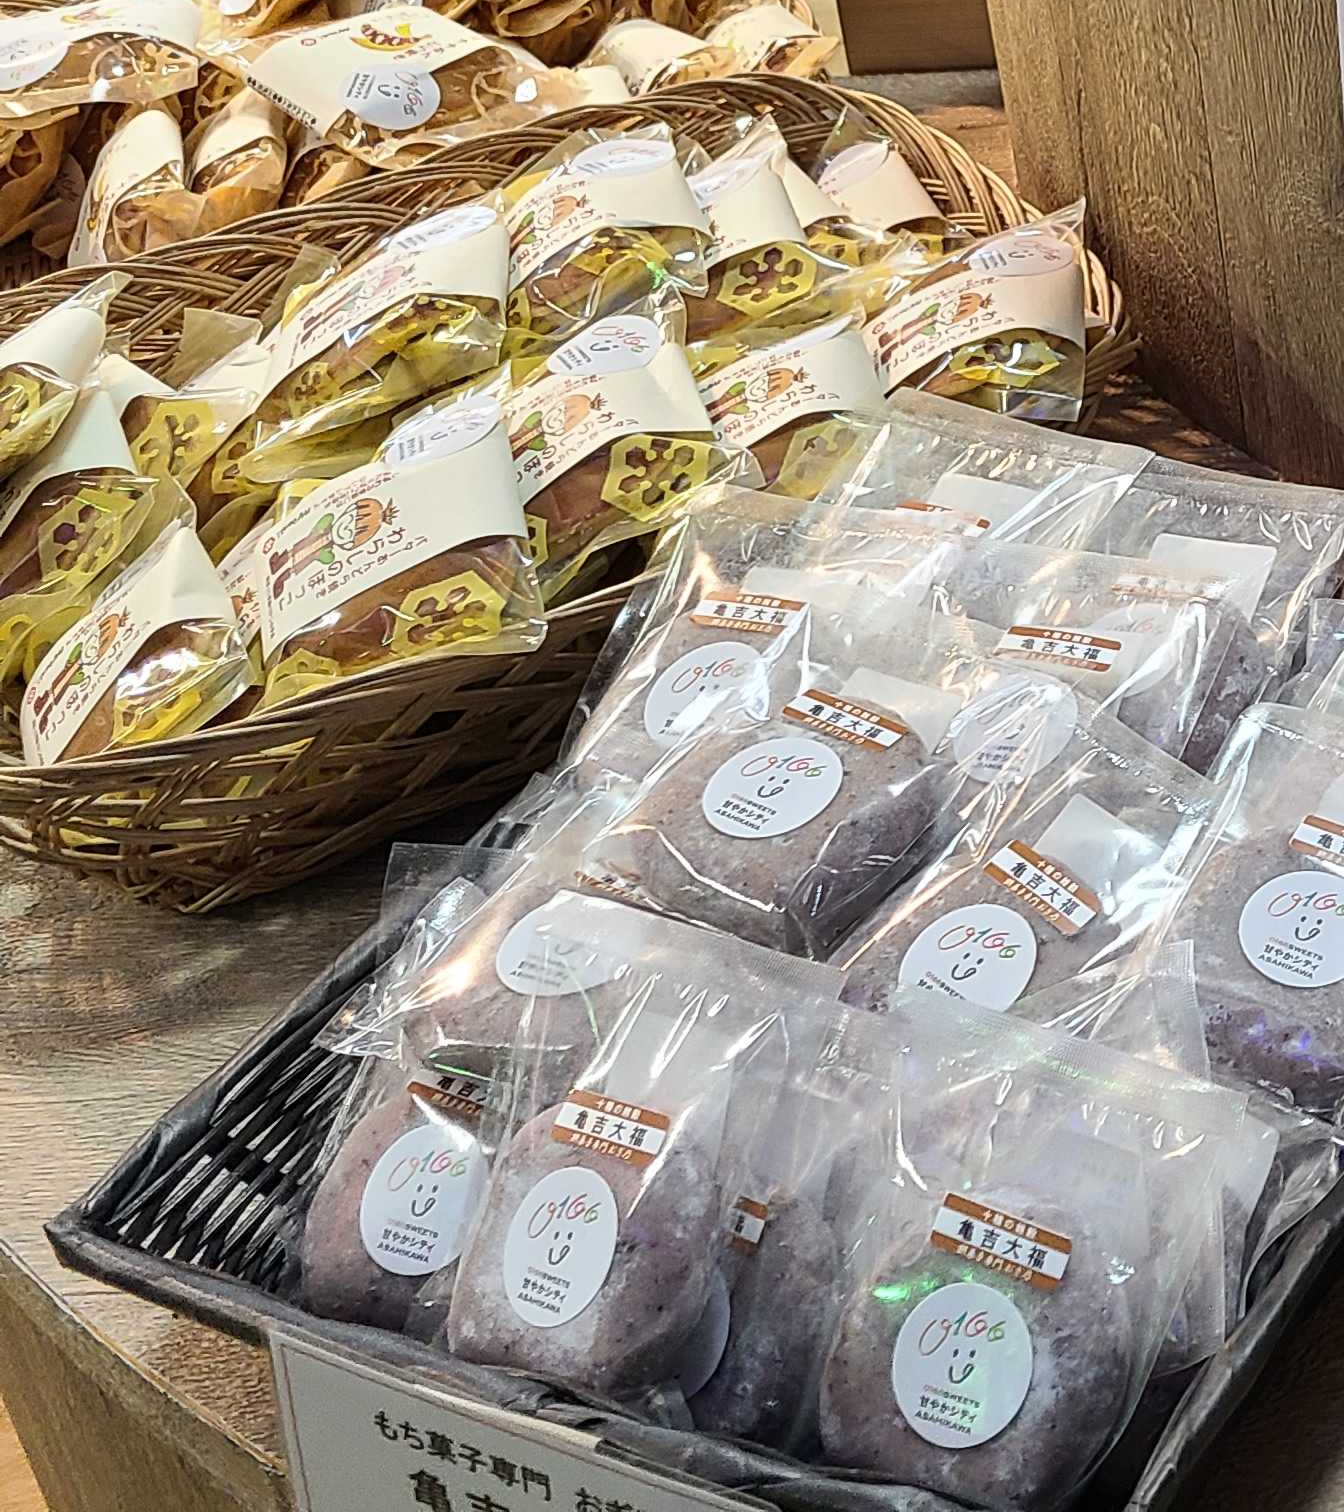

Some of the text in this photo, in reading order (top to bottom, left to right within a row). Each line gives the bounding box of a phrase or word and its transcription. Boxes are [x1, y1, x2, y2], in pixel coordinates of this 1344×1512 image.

[1020, 635, 1100, 661] 亀吉大福
[808, 703, 884, 740] 亀吉大福
[741, 754, 823, 778] 0166
[1009, 861, 1081, 916] 亀吉大福
[938, 925, 1021, 959] 0166
[574, 1110, 647, 1146] 亀吉大福
[387, 1149, 468, 1191] 0166
[528, 1194, 600, 1237] 0166
[957, 1218, 1047, 1269] 亀吉大福
[918, 1311, 1006, 1355] 0166
[374, 1411, 551, 1501] もち菓子専門
